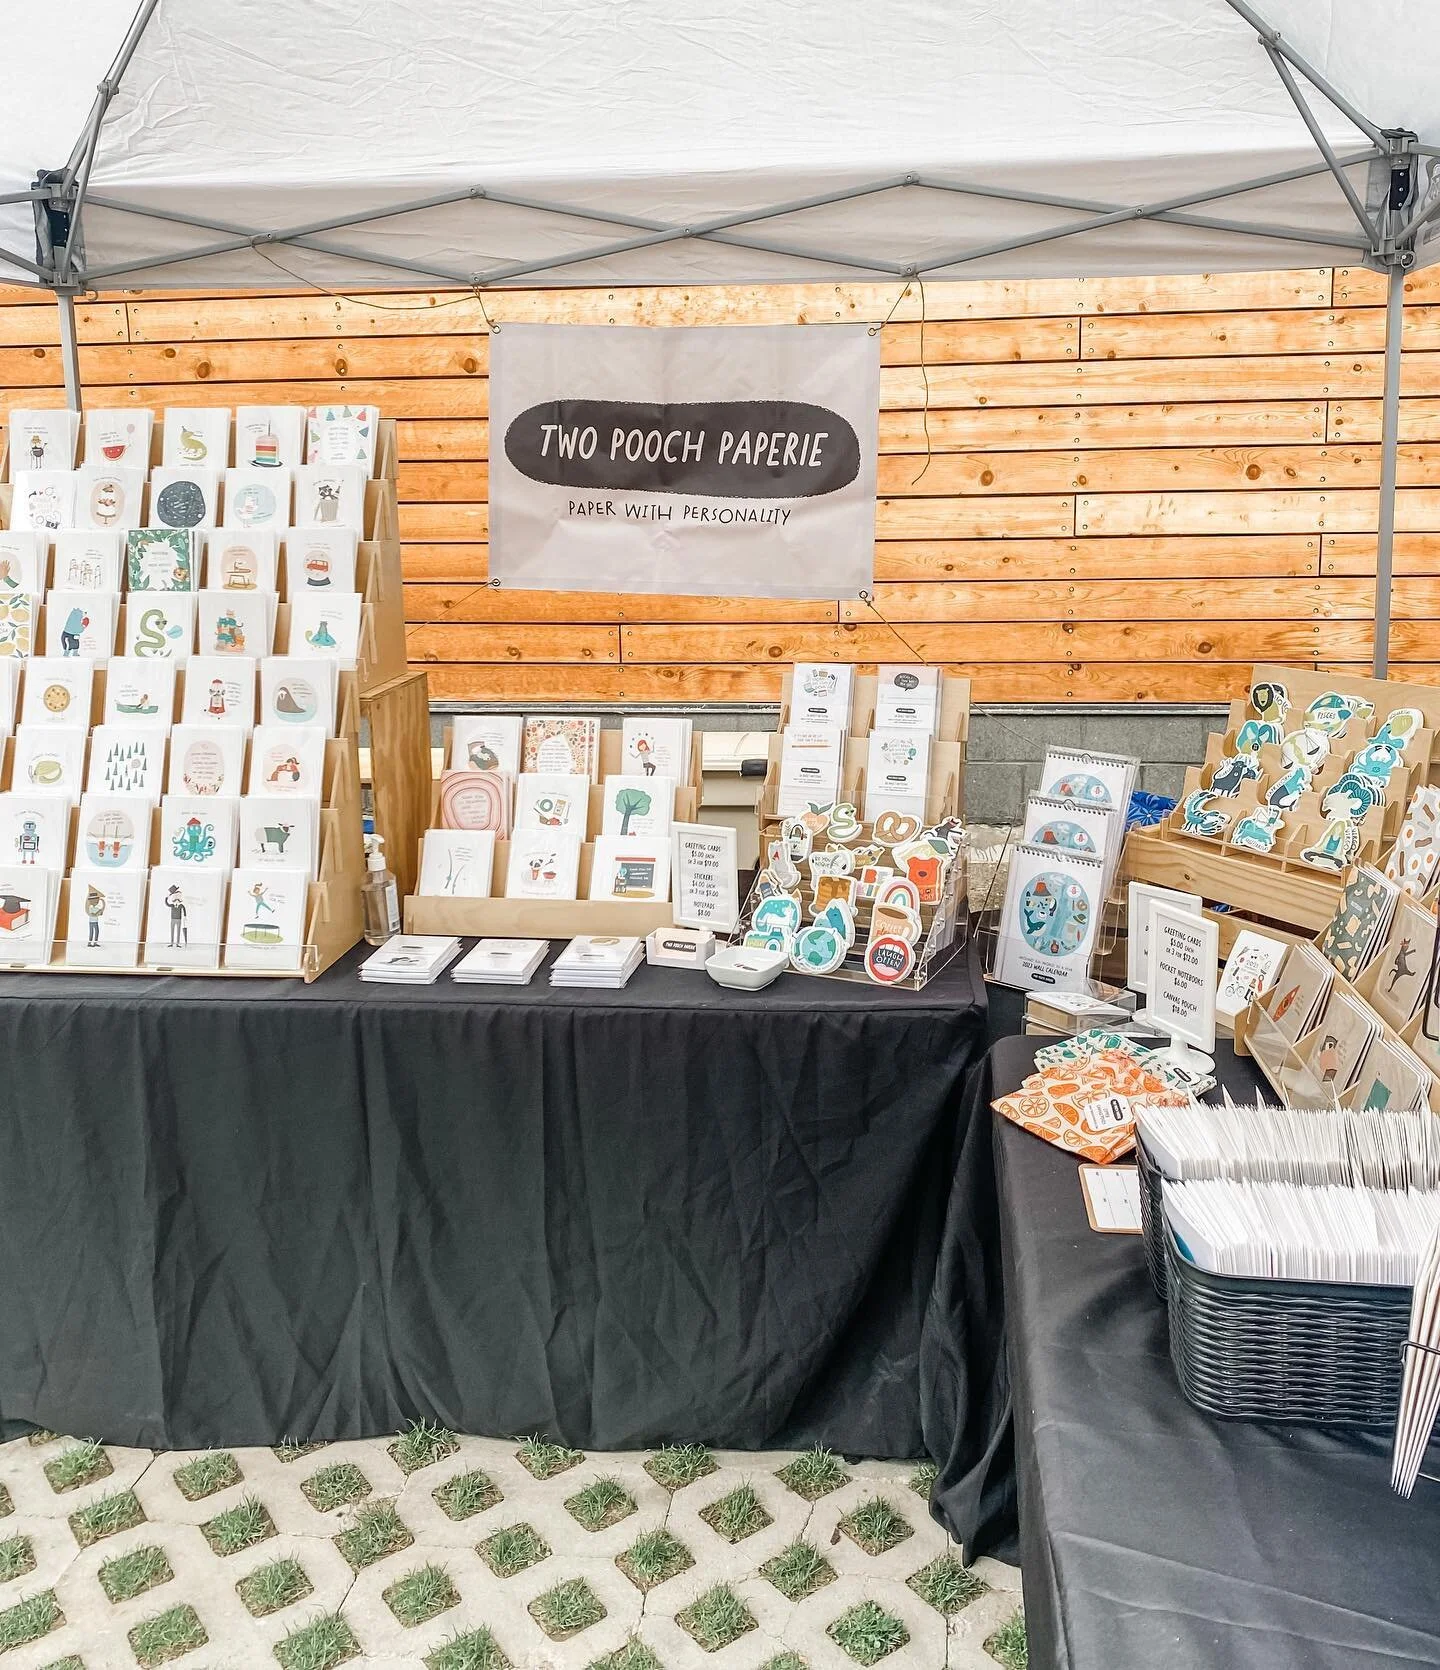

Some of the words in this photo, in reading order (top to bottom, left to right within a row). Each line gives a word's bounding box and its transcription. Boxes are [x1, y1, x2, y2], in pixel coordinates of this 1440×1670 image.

[540, 424, 598, 461] TWO
[609, 427, 704, 463] POOCH
[718, 431, 829, 468] PAPERIE
[568, 500, 617, 517] PAPER
[625, 503, 673, 521] WITH
[683, 505, 792, 526] PERSONALITY
[1317, 710, 1336, 720] PISCES
[685, 842, 706, 851] GREETING
[707, 844, 721, 852] CARDS
[691, 850, 704, 858] $5.00
[693, 873, 713, 881] STICKERS
[693, 900, 715, 909] NOTEPADS
[697, 909, 711, 917] $8.00
[1163, 926, 1186, 941] GREETING
[1186, 935, 1202, 947] CARDS
[1170, 937, 1184, 949] $5.00
[1184, 945, 1194, 953] EACH
[877, 948, 904, 961] LAUGH
[1182, 952, 1199, 965] $12.00
[876, 956, 900, 968] OFTEN
[1022, 961, 1033, 969] 2023
[1033, 964, 1045, 972] WALL
[1045, 967, 1068, 977] CALENDAR
[1159, 961, 1177, 974] POCKET
[1177, 969, 1204, 987] NOTEBOOKS
[1174, 977, 1188, 990] $6.00
[1163, 991, 1181, 1005] CANVAS
[1181, 999, 1198, 1012] POUCH
[1172, 1004, 1188, 1017] $18.00
